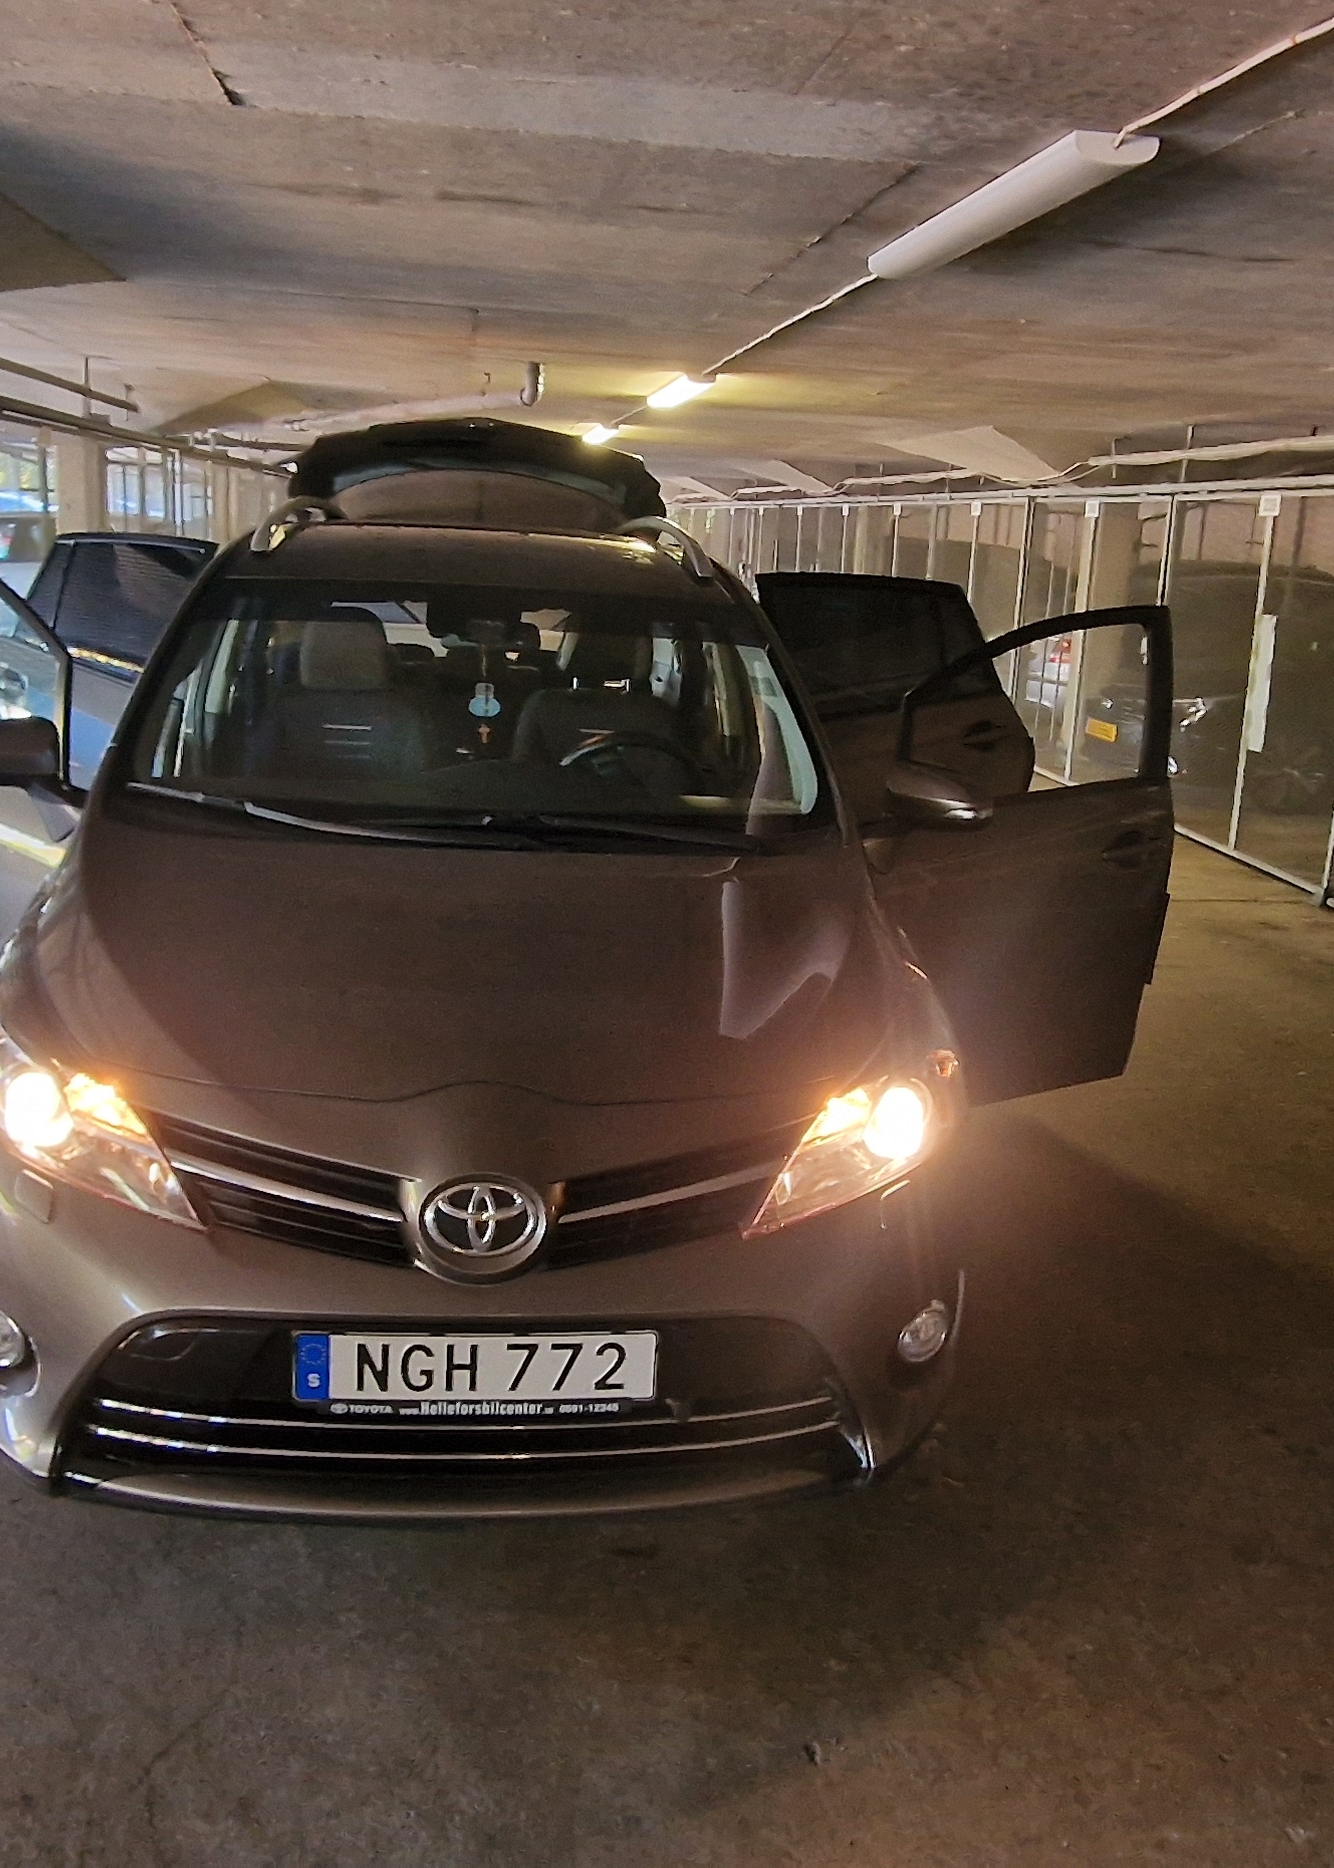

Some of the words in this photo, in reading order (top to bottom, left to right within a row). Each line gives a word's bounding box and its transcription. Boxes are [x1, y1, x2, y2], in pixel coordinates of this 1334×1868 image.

[356, 1343, 479, 1392] NGH
[506, 1342, 627, 1392] 772
[307, 1373, 320, 1387] S
[349, 1404, 393, 1414] TOYOTA
